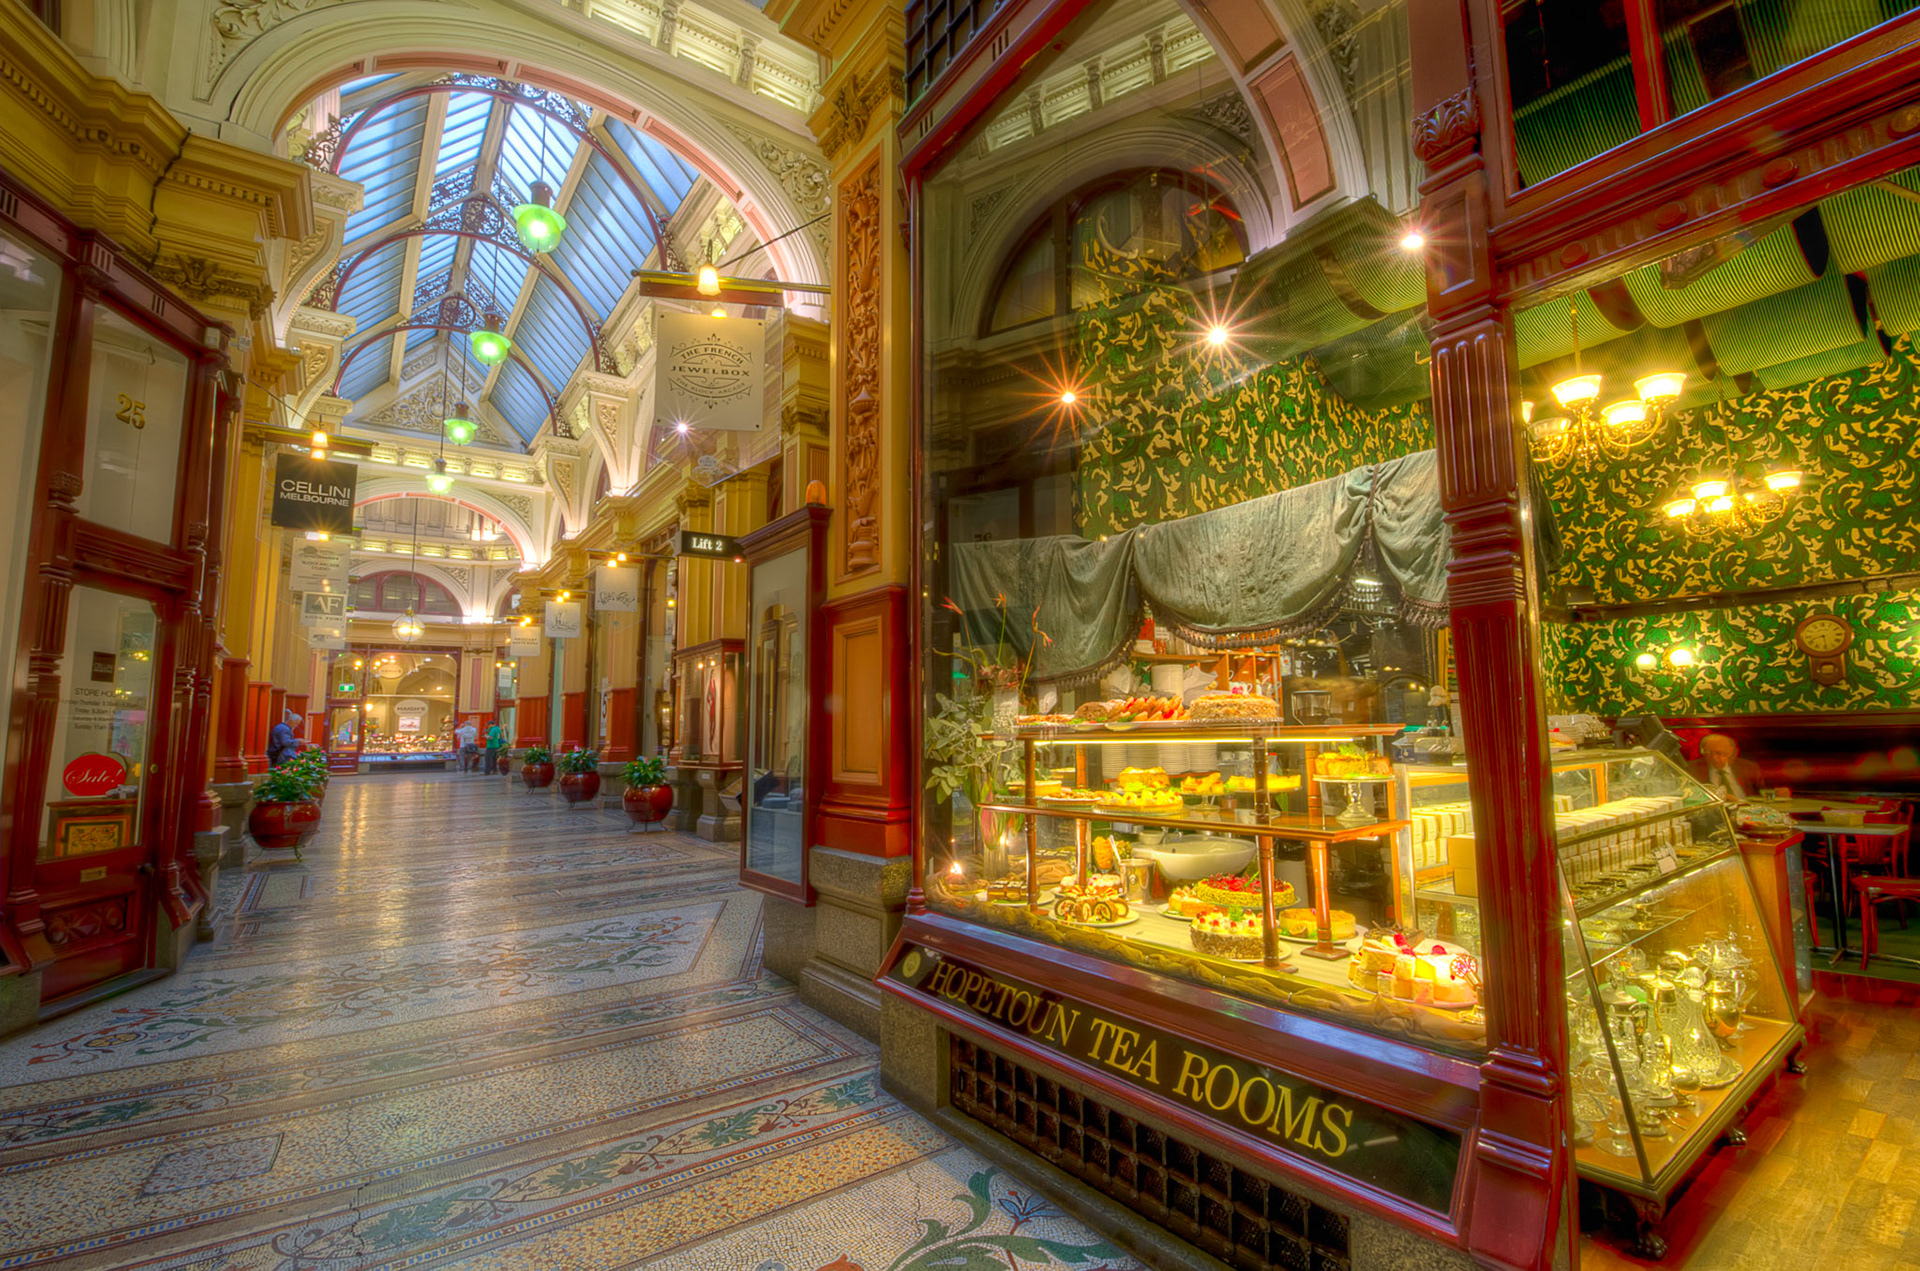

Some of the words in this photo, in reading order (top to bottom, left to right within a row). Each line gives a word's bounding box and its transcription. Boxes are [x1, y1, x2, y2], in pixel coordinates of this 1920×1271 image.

[680, 348, 701, 360] THE
[704, 346, 744, 365] FRENCH
[670, 365, 751, 377] JEWELBOX
[690, 386, 713, 395] BLOCK
[115, 393, 146, 430] 25
[281, 479, 351, 499] CELLINI
[280, 491, 349, 507] MELBOURNE
[691, 537, 713, 550] Lift
[715, 540, 723, 551] 2
[75, 687, 99, 697] STORE
[65, 768, 122, 785] Sale!
[927, 960, 1081, 1047] HOPETOUN
[1087, 1018, 1160, 1085] TEA
[1172, 1050, 1353, 1157] ROOMS
